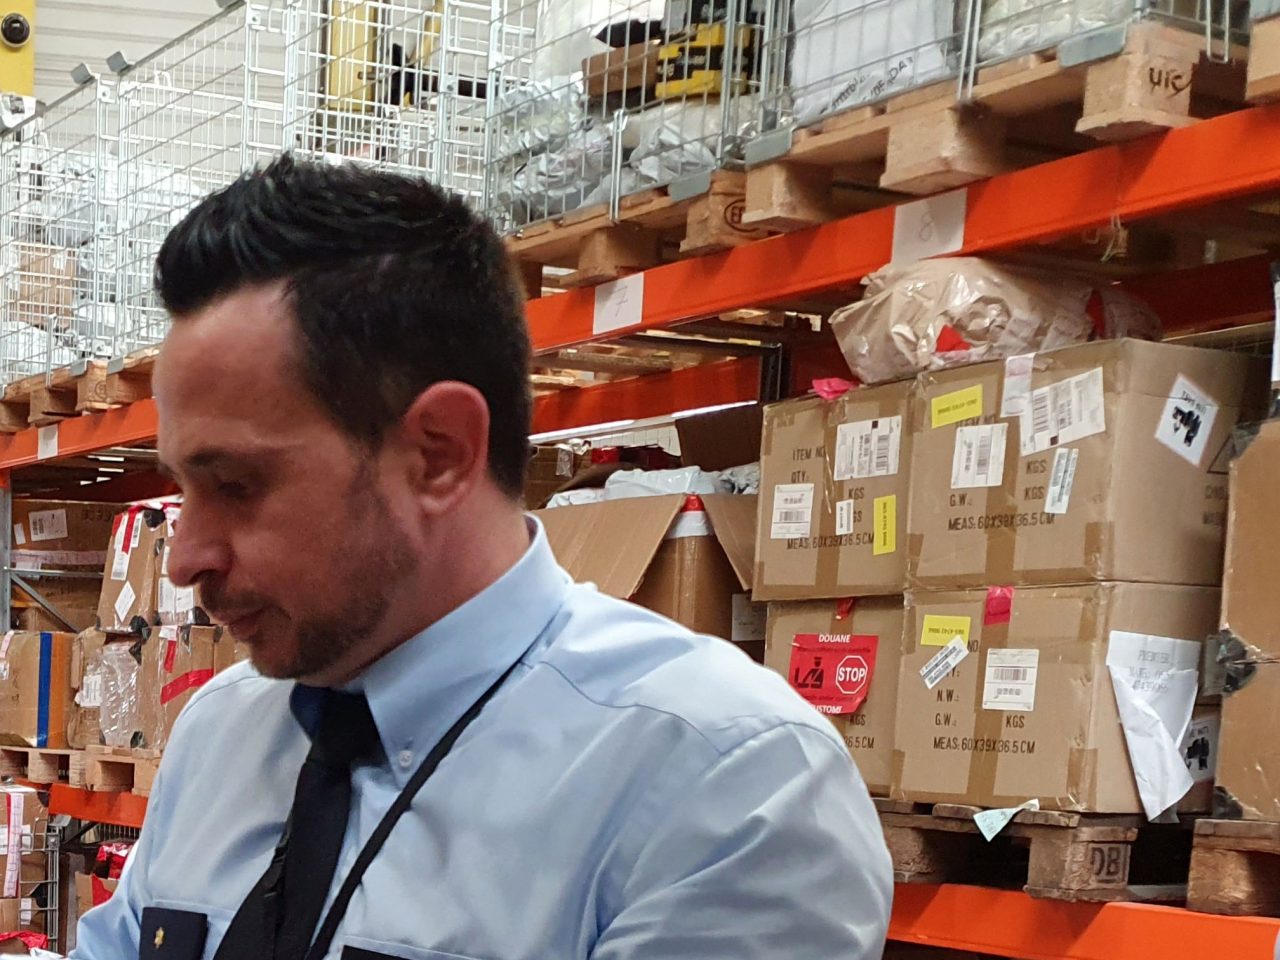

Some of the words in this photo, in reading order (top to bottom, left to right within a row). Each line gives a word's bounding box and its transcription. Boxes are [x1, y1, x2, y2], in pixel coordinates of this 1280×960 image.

[792, 447, 812, 461] ITEM
[1026, 459, 1048, 474] KGS
[848, 487, 865, 501] KGS
[1024, 486, 1045, 501] KGS
[853, 510, 863, 523] GS
[818, 634, 852, 643] DOUANE
[837, 666, 867, 683] STOP
[1005, 715, 1025, 729] KGS
[933, 737, 961, 750] MEAS:
[1020, 741, 1036, 754] CM
[1090, 847, 1122, 876] DB
